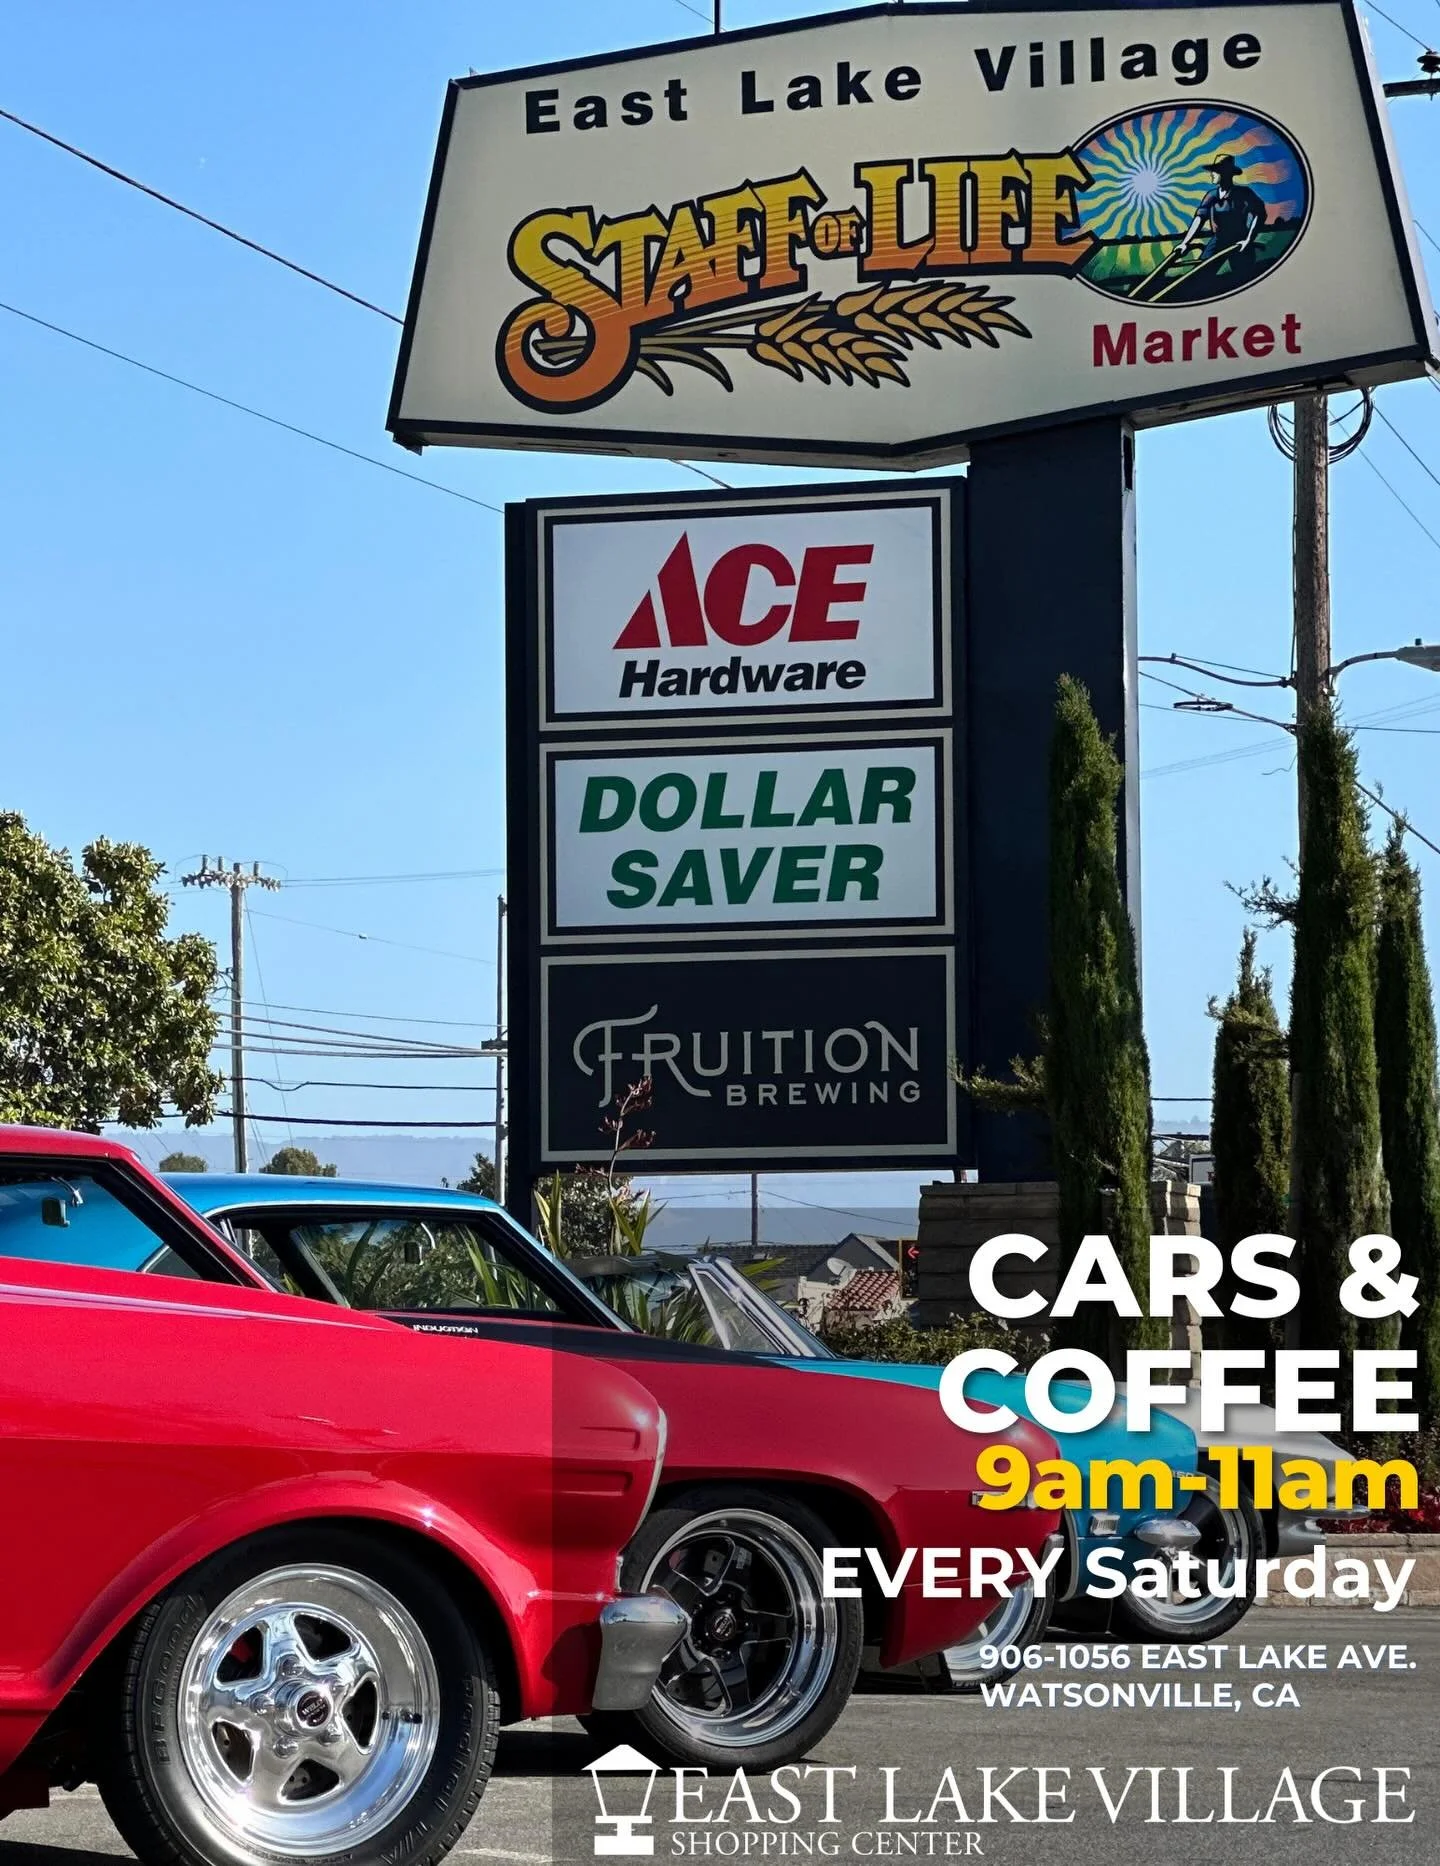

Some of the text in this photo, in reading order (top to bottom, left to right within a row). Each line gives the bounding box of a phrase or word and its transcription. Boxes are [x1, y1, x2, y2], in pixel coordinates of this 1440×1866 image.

[525, 33, 1262, 135] East Lake Village
[495, 147, 1101, 414] STAFF OF LIFE
[1093, 314, 1303, 367] Market
[612, 531, 875, 650] ACE
[619, 656, 866, 698] Hardware
[579, 766, 917, 834] DOLLAR
[606, 843, 884, 909] SAVER
[573, 1003, 919, 1108] FRUITION
[726, 1080, 922, 1107] BREWING
